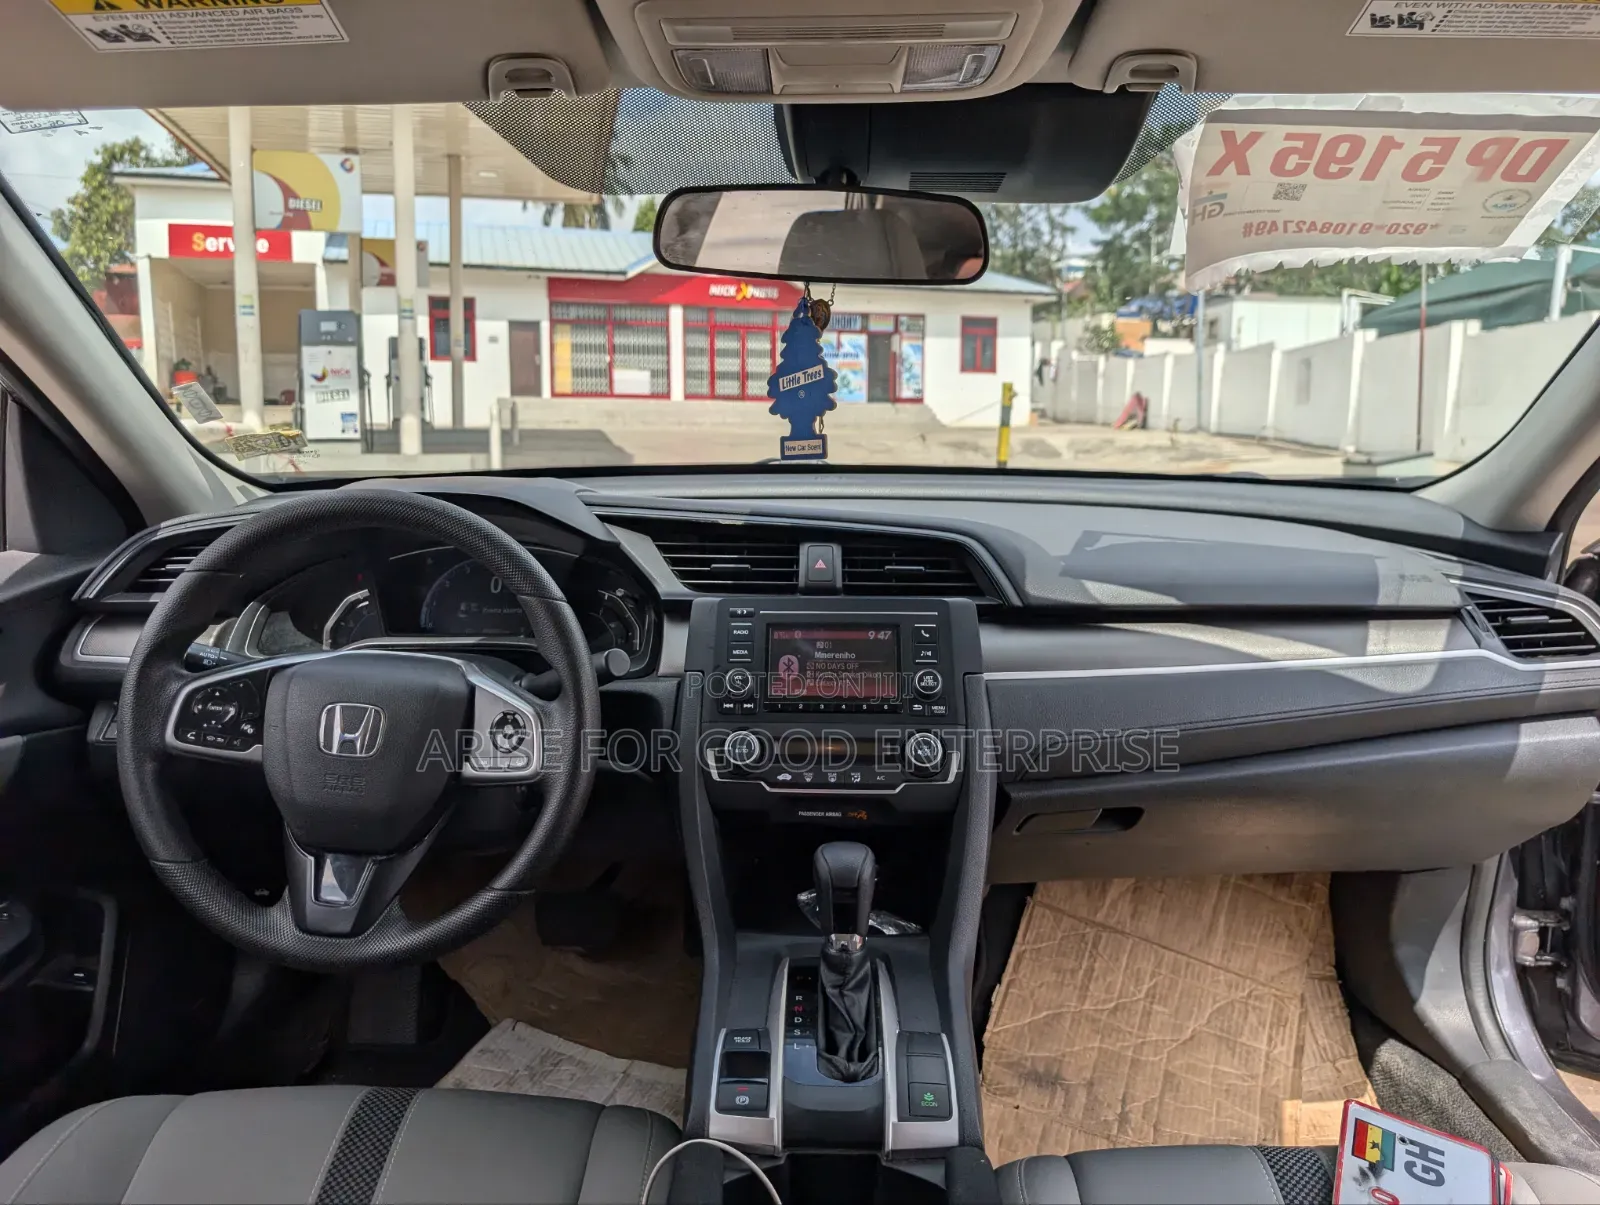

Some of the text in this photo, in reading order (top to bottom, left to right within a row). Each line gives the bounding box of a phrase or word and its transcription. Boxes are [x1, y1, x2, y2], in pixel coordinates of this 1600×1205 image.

[131, 12, 168, 21] WITH
[169, 8, 240, 19] ADVANCED
[243, 7, 264, 16] AIR
[266, 6, 304, 15] BAGS
[287, 198, 323, 212] DIESEL
[191, 232, 270, 253] Serve
[781, 369, 822, 390] Little Trees
[785, 444, 796, 452] New
[490, 576, 503, 594] 0
[199, 651, 215, 659] AUTO
[816, 662, 859, 670] NO DAYS OFF
[793, 1042, 801, 1050] L
[920, 1100, 938, 1108] ECON
[1403, 1137, 1446, 1188] GH
